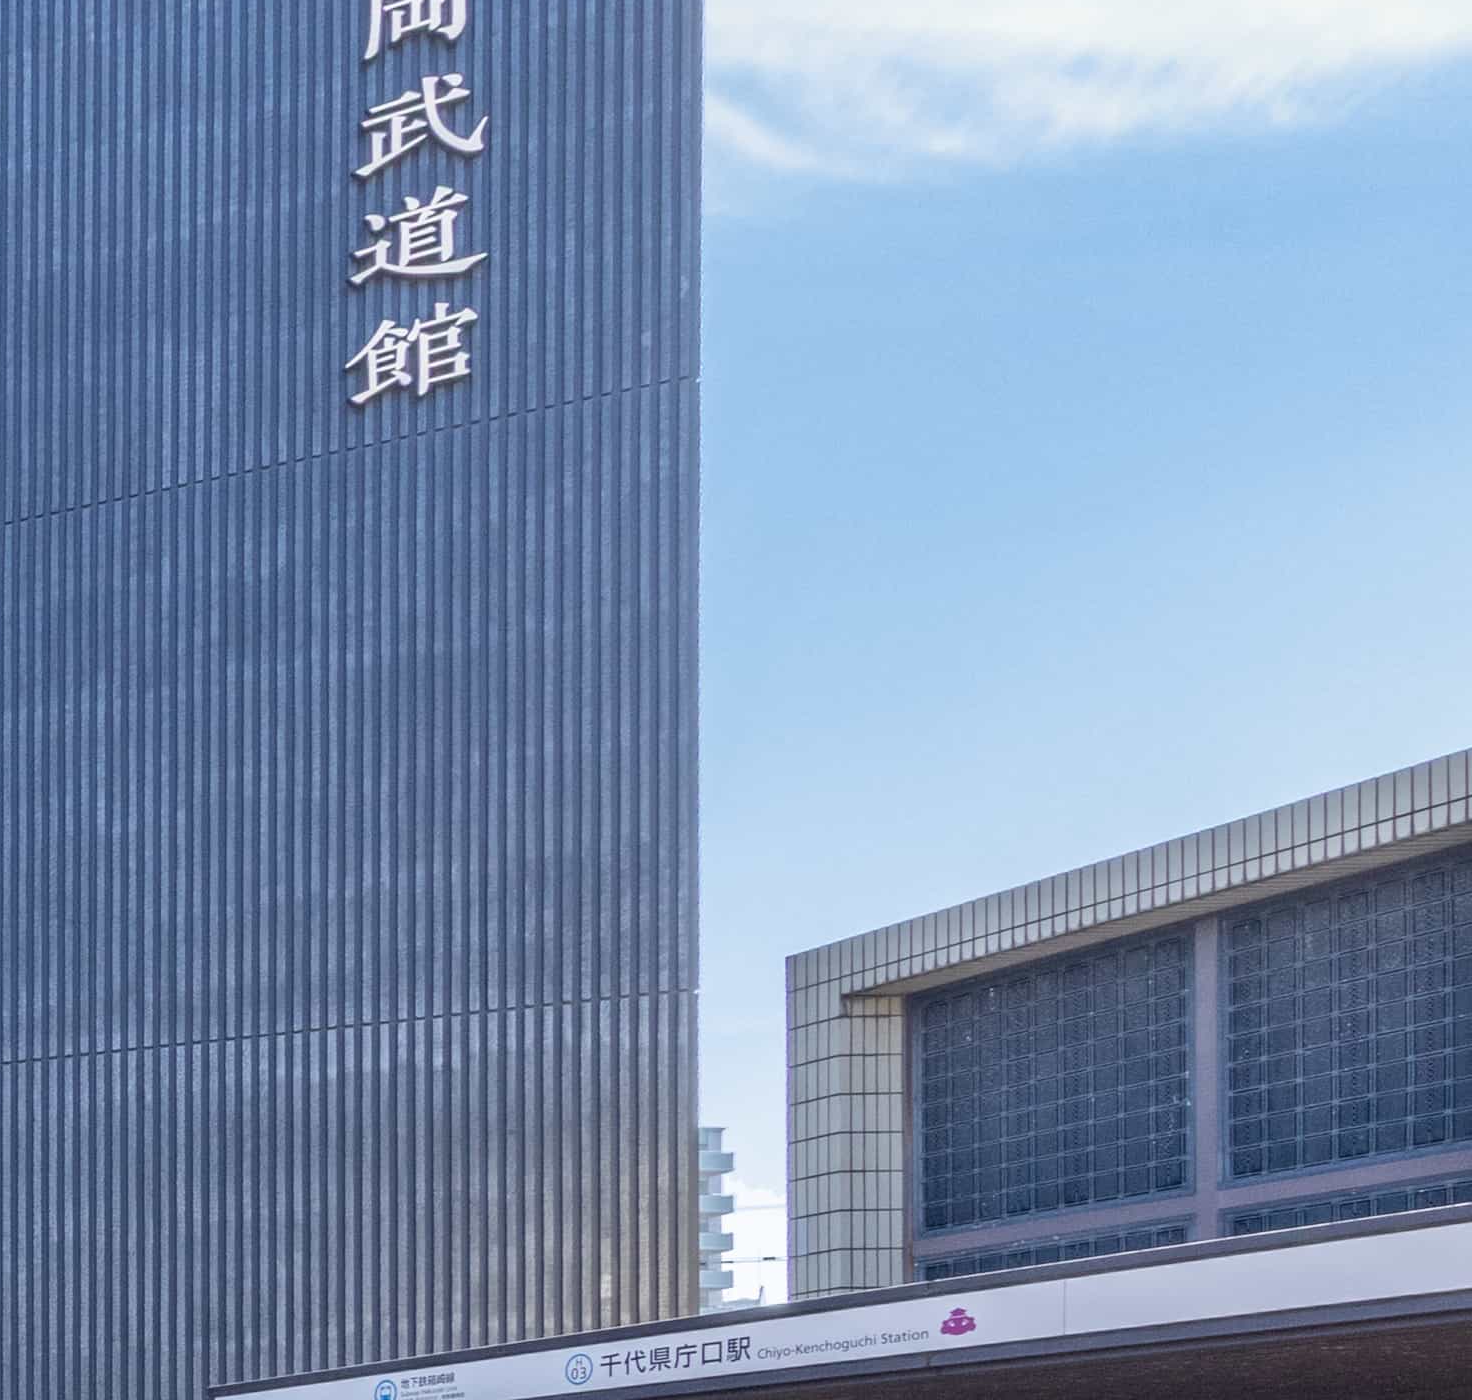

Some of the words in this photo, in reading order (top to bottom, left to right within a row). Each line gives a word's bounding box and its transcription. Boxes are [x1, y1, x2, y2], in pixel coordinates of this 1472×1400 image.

[600, 1336, 751, 1378] 千代県庁口駅
[756, 1333, 877, 1361] Chiyo-Kenchoguchi
[880, 1329, 930, 1345] Station
[570, 1366, 587, 1380] 03
